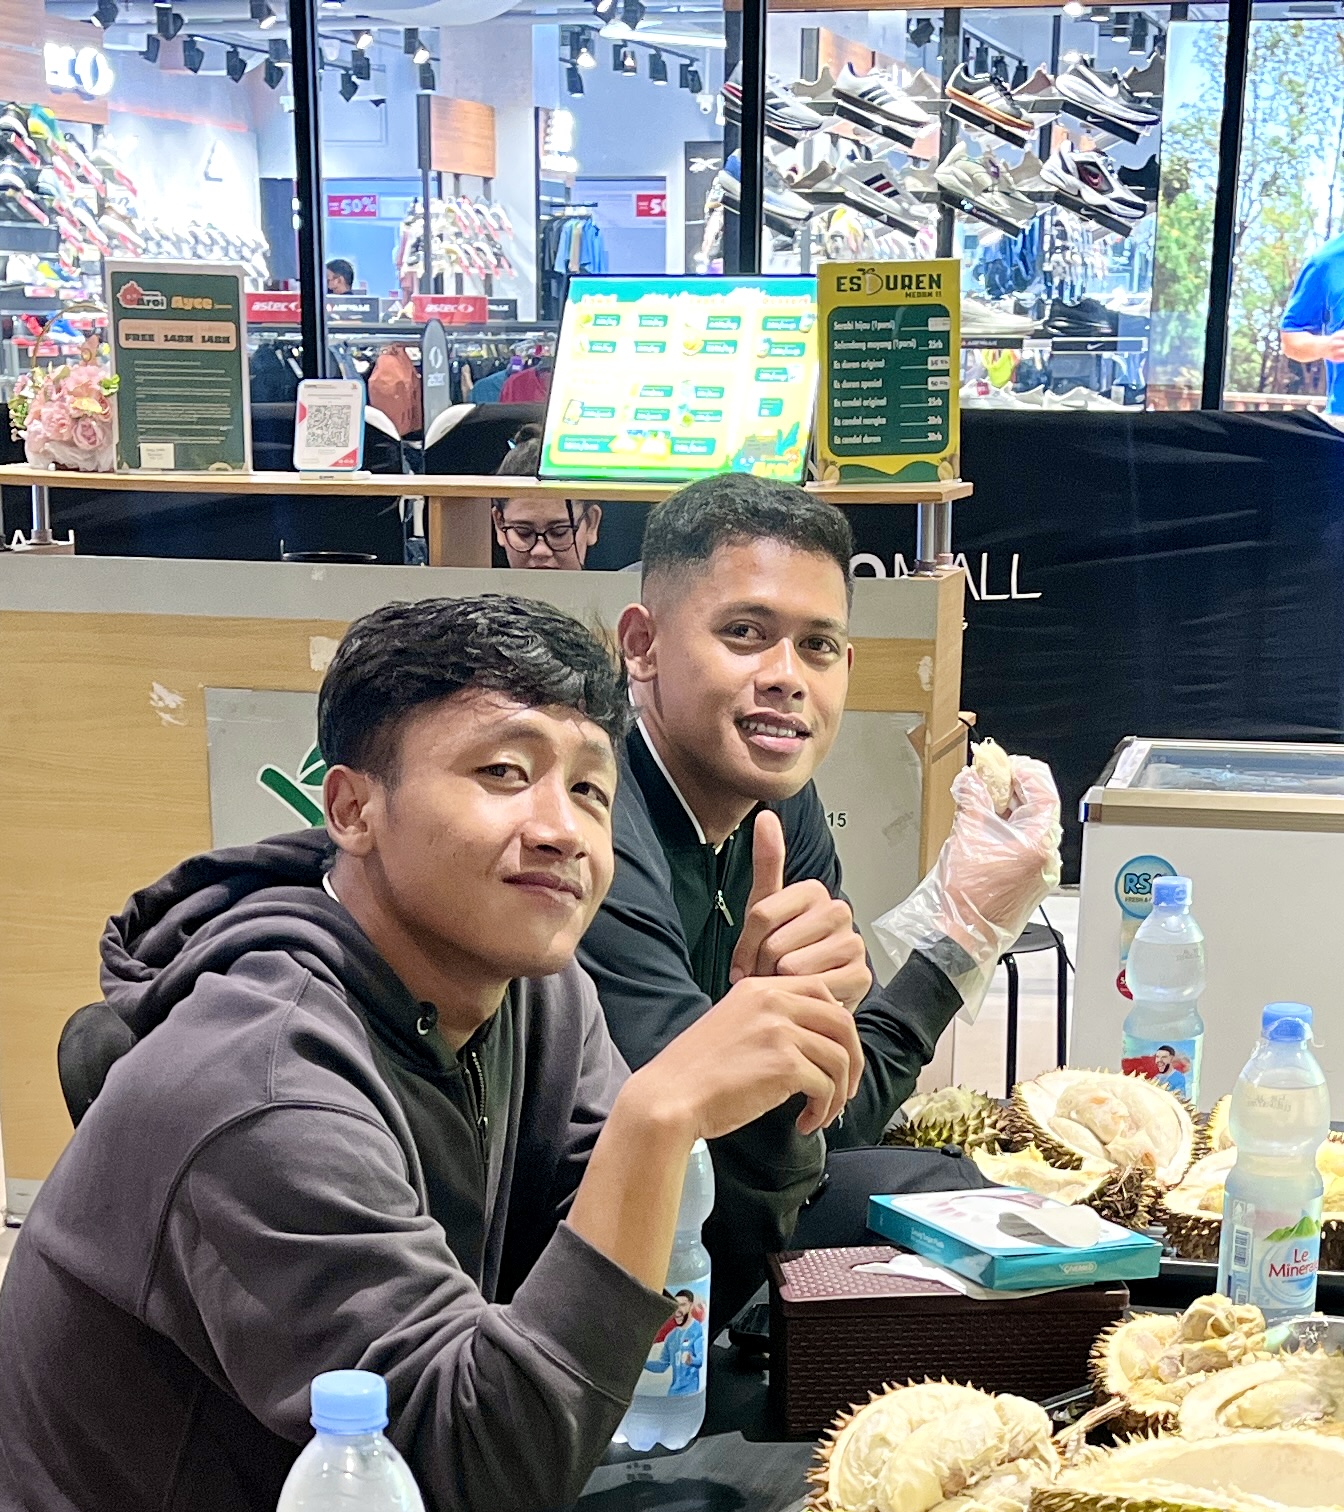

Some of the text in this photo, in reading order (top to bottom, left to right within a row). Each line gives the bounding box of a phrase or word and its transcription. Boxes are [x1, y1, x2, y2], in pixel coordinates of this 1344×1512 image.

[340, 196, 377, 215] 50%
[835, 275, 862, 293] ES
[1123, 872, 1168, 895] RS
[1293, 1248, 1309, 1264] Le
